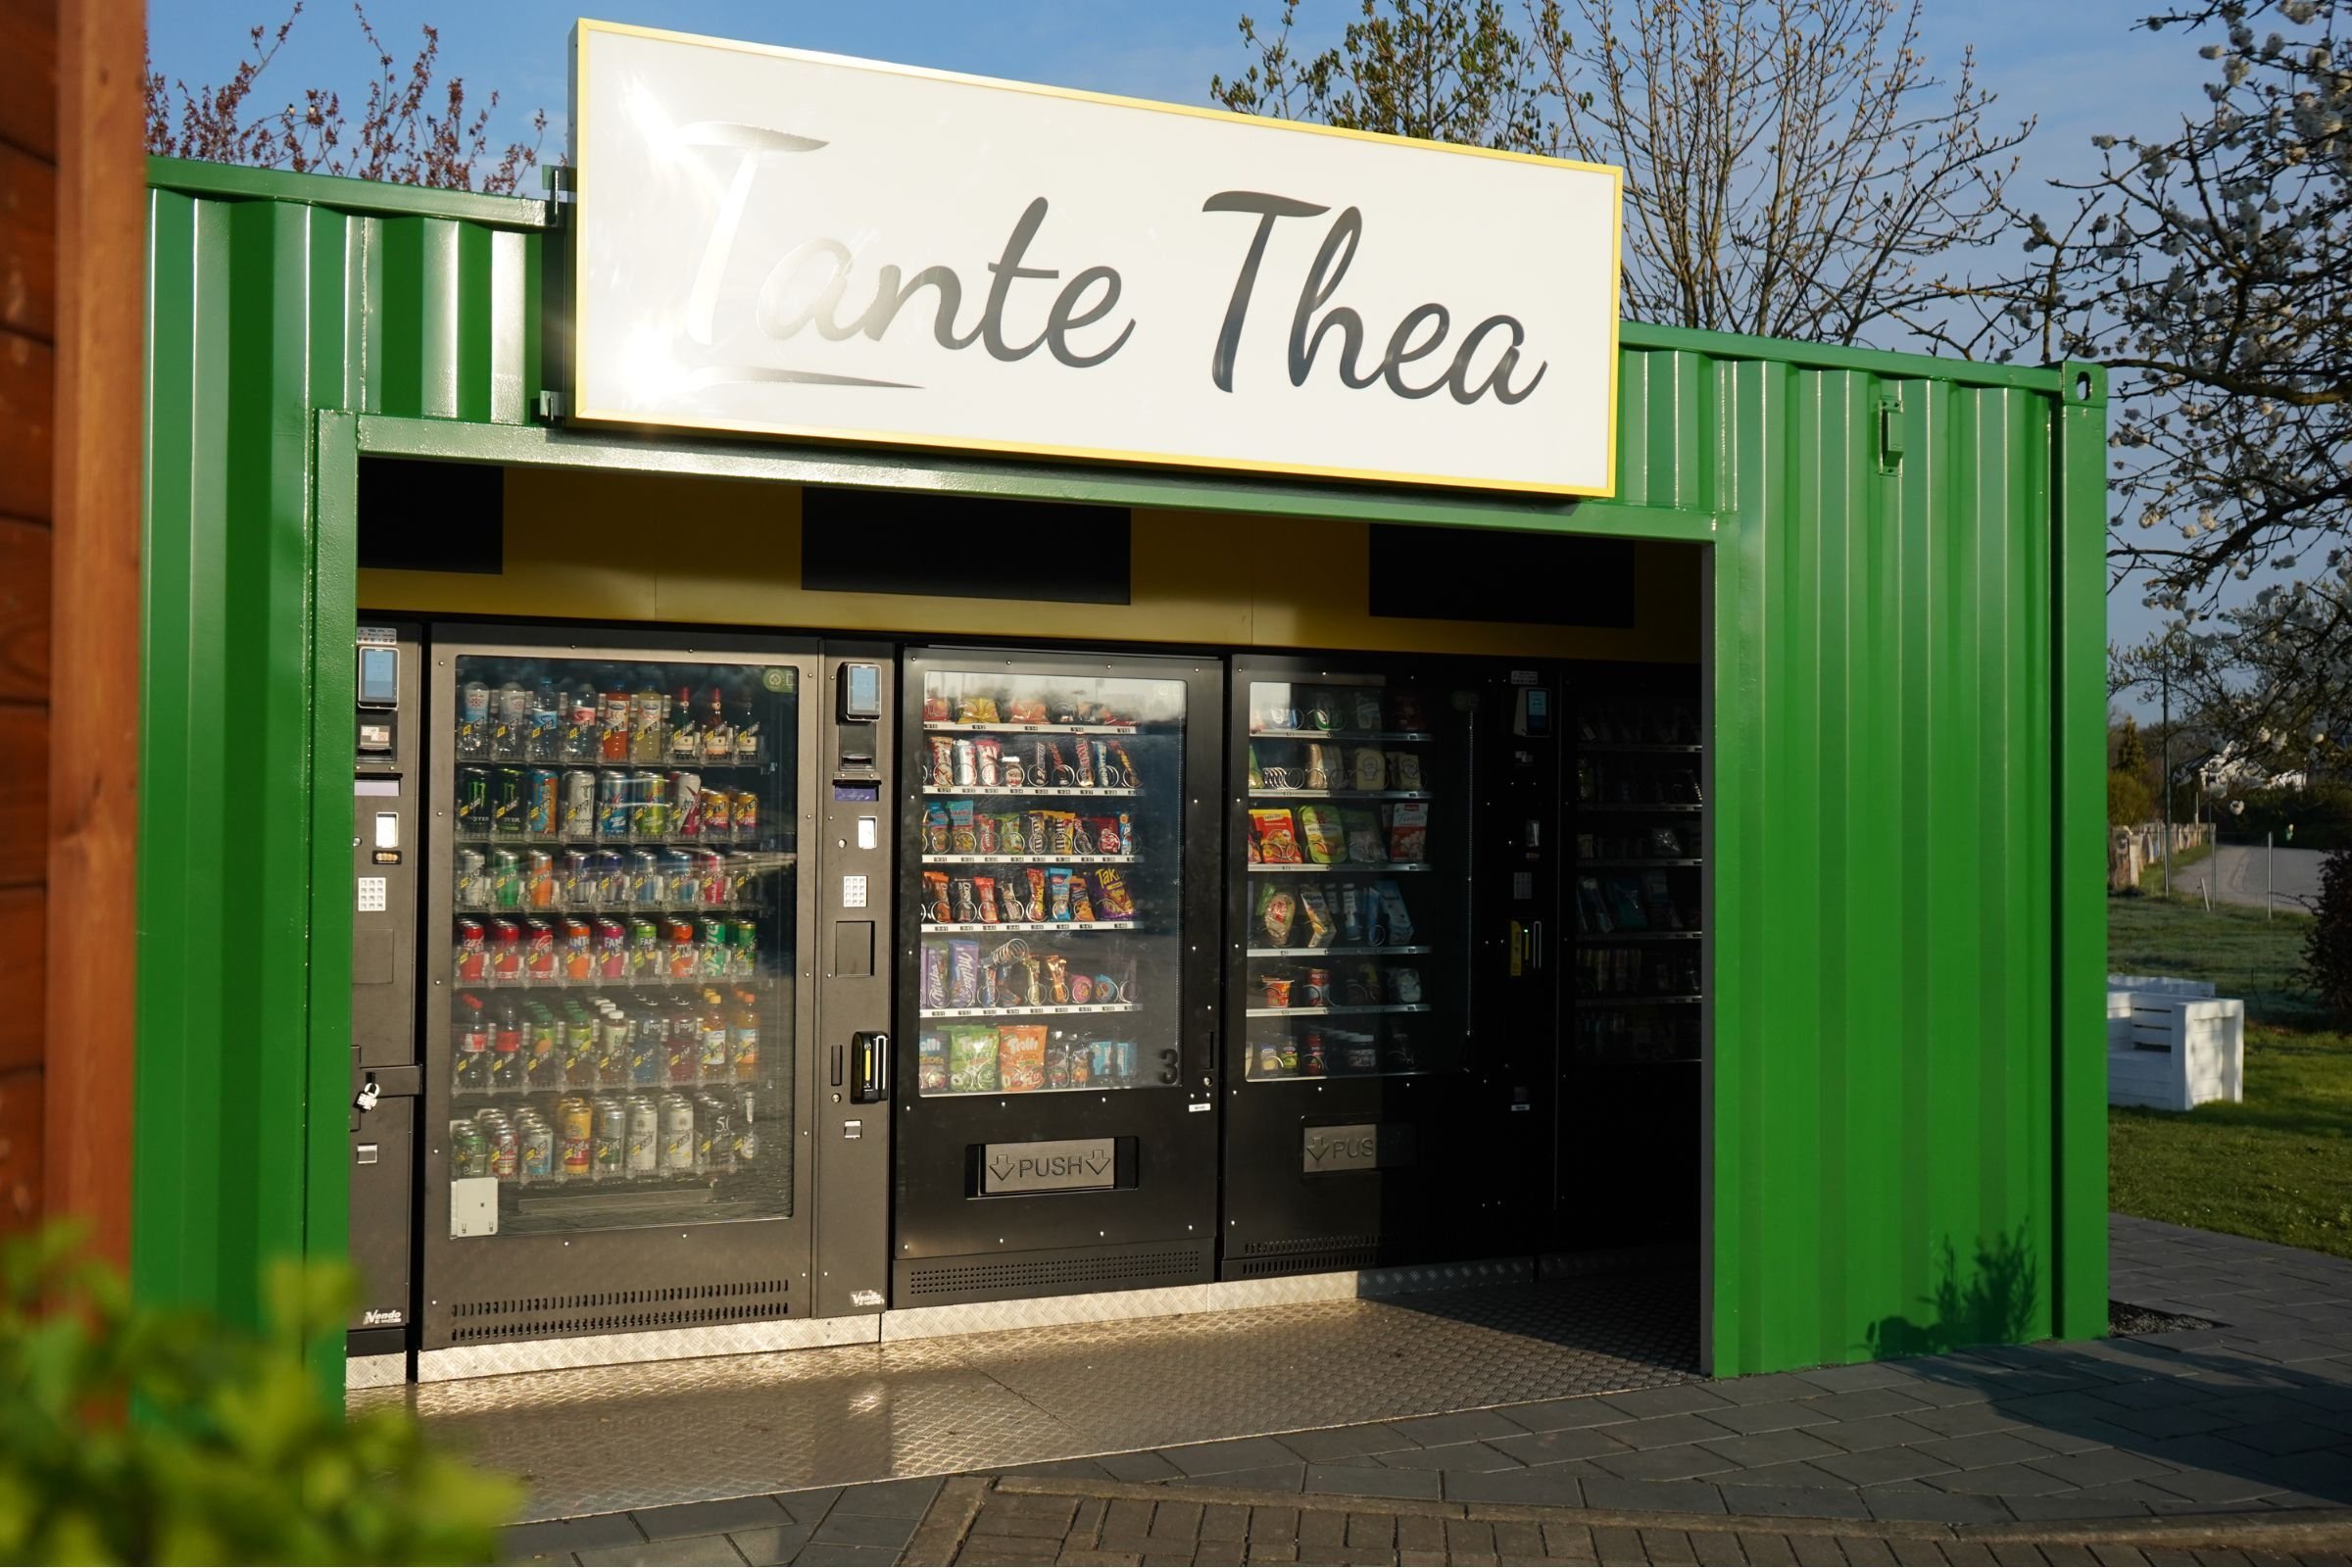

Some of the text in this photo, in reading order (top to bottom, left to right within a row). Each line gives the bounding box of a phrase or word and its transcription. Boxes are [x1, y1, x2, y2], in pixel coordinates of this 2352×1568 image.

[676, 122, 1548, 405] Tante Thea
[1006, 1036, 1039, 1054] Trolli
[1158, 1048, 1179, 1084] 3
[1332, 1138, 1384, 1160] PUS
[1018, 1155, 1083, 1178] PUSH
[365, 1309, 402, 1324] Vendo
